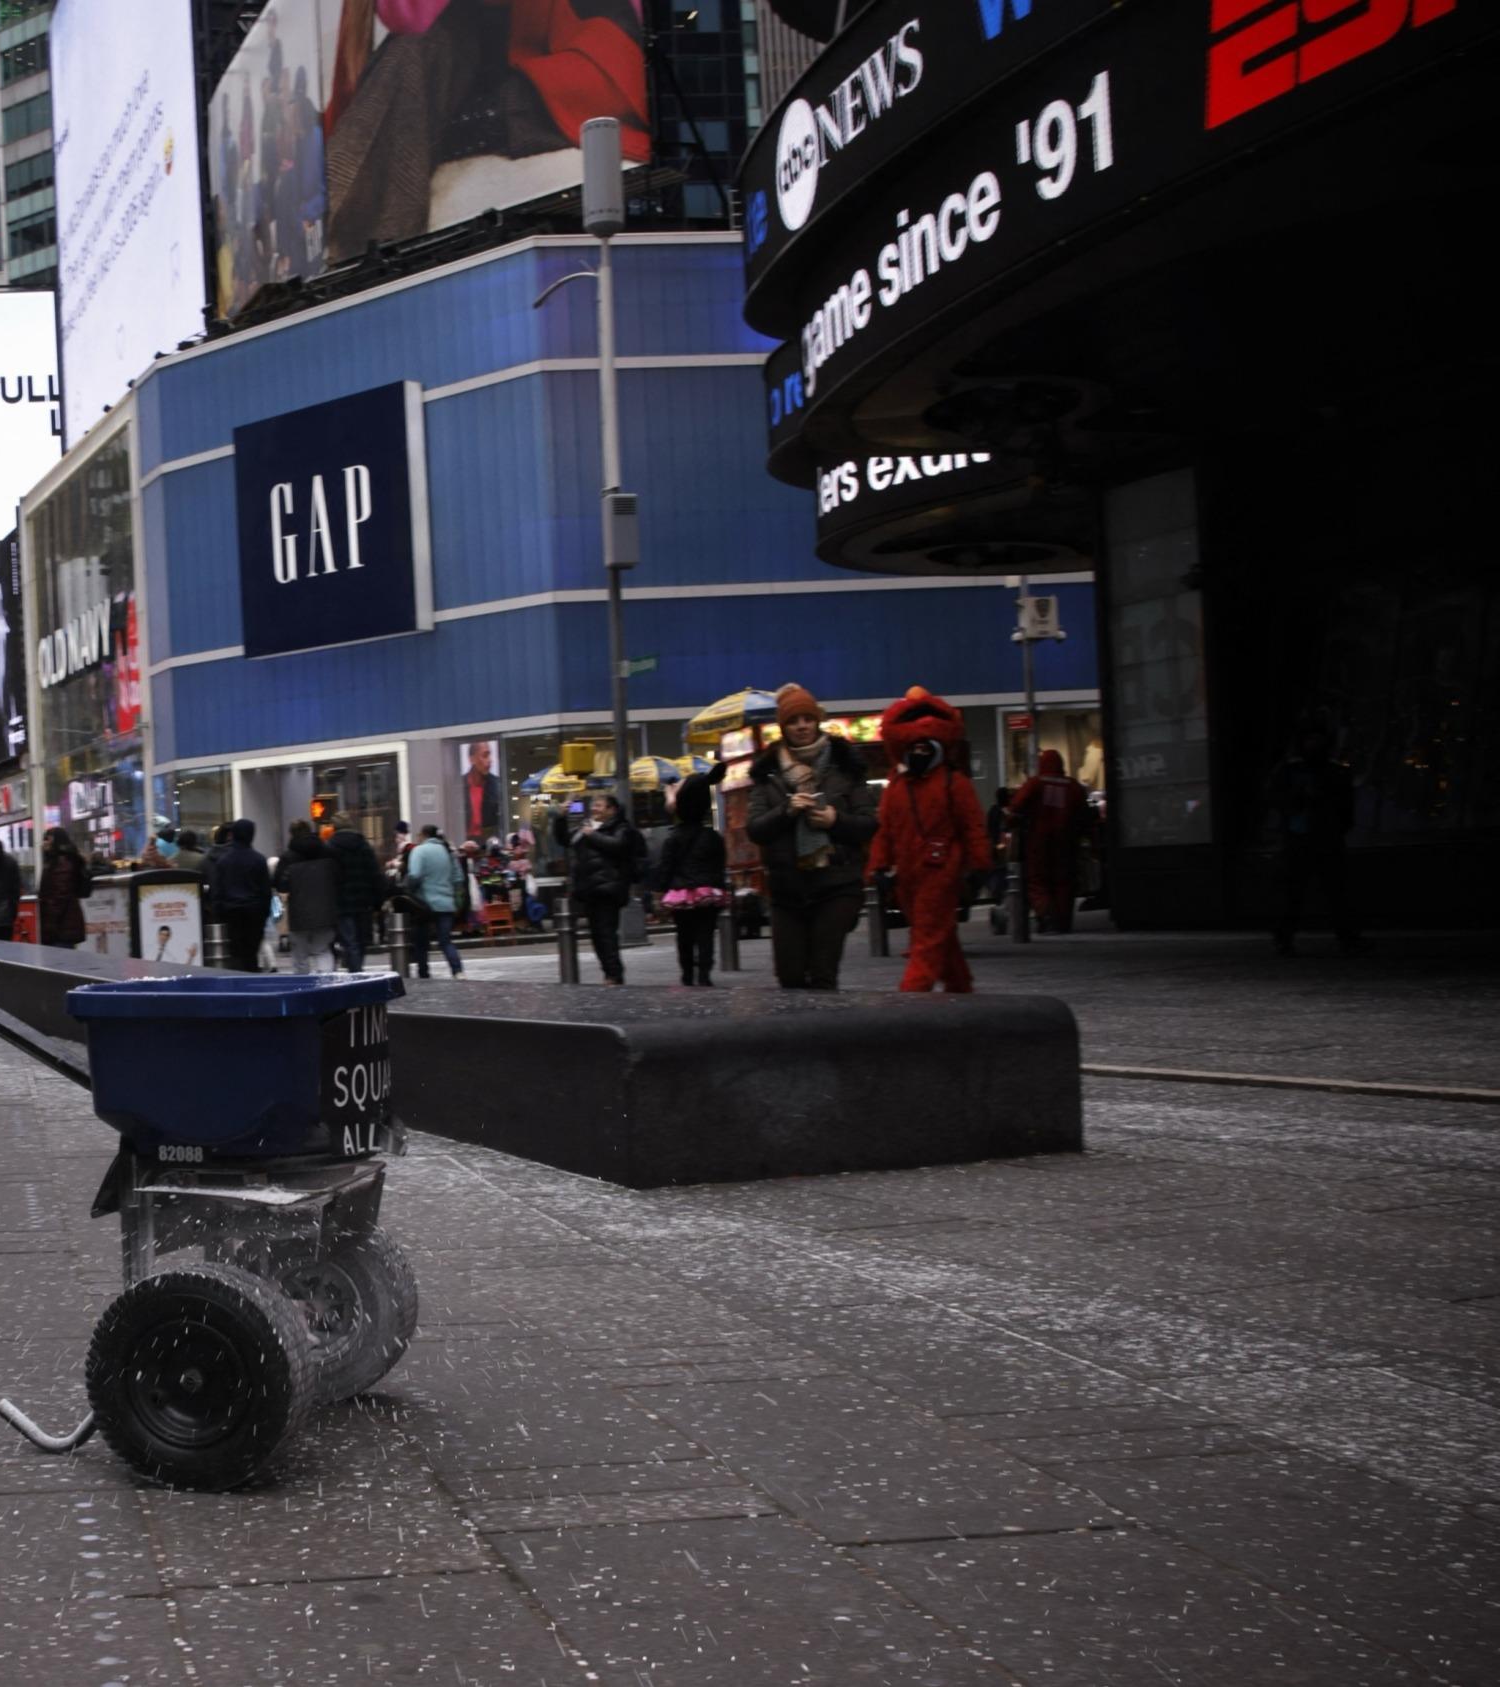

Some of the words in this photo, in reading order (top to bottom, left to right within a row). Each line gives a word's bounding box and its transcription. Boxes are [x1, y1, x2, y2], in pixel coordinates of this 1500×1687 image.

[812, 18, 924, 167] NEWS
[802, 268, 873, 398] game
[878, 171, 1001, 307] since
[1015, 71, 1115, 200] '91
[270, 464, 373, 584] GAP
[38, 627, 67, 689] OLD
[67, 598, 111, 676] NAVY
[158, 1145, 203, 1162] 82088
